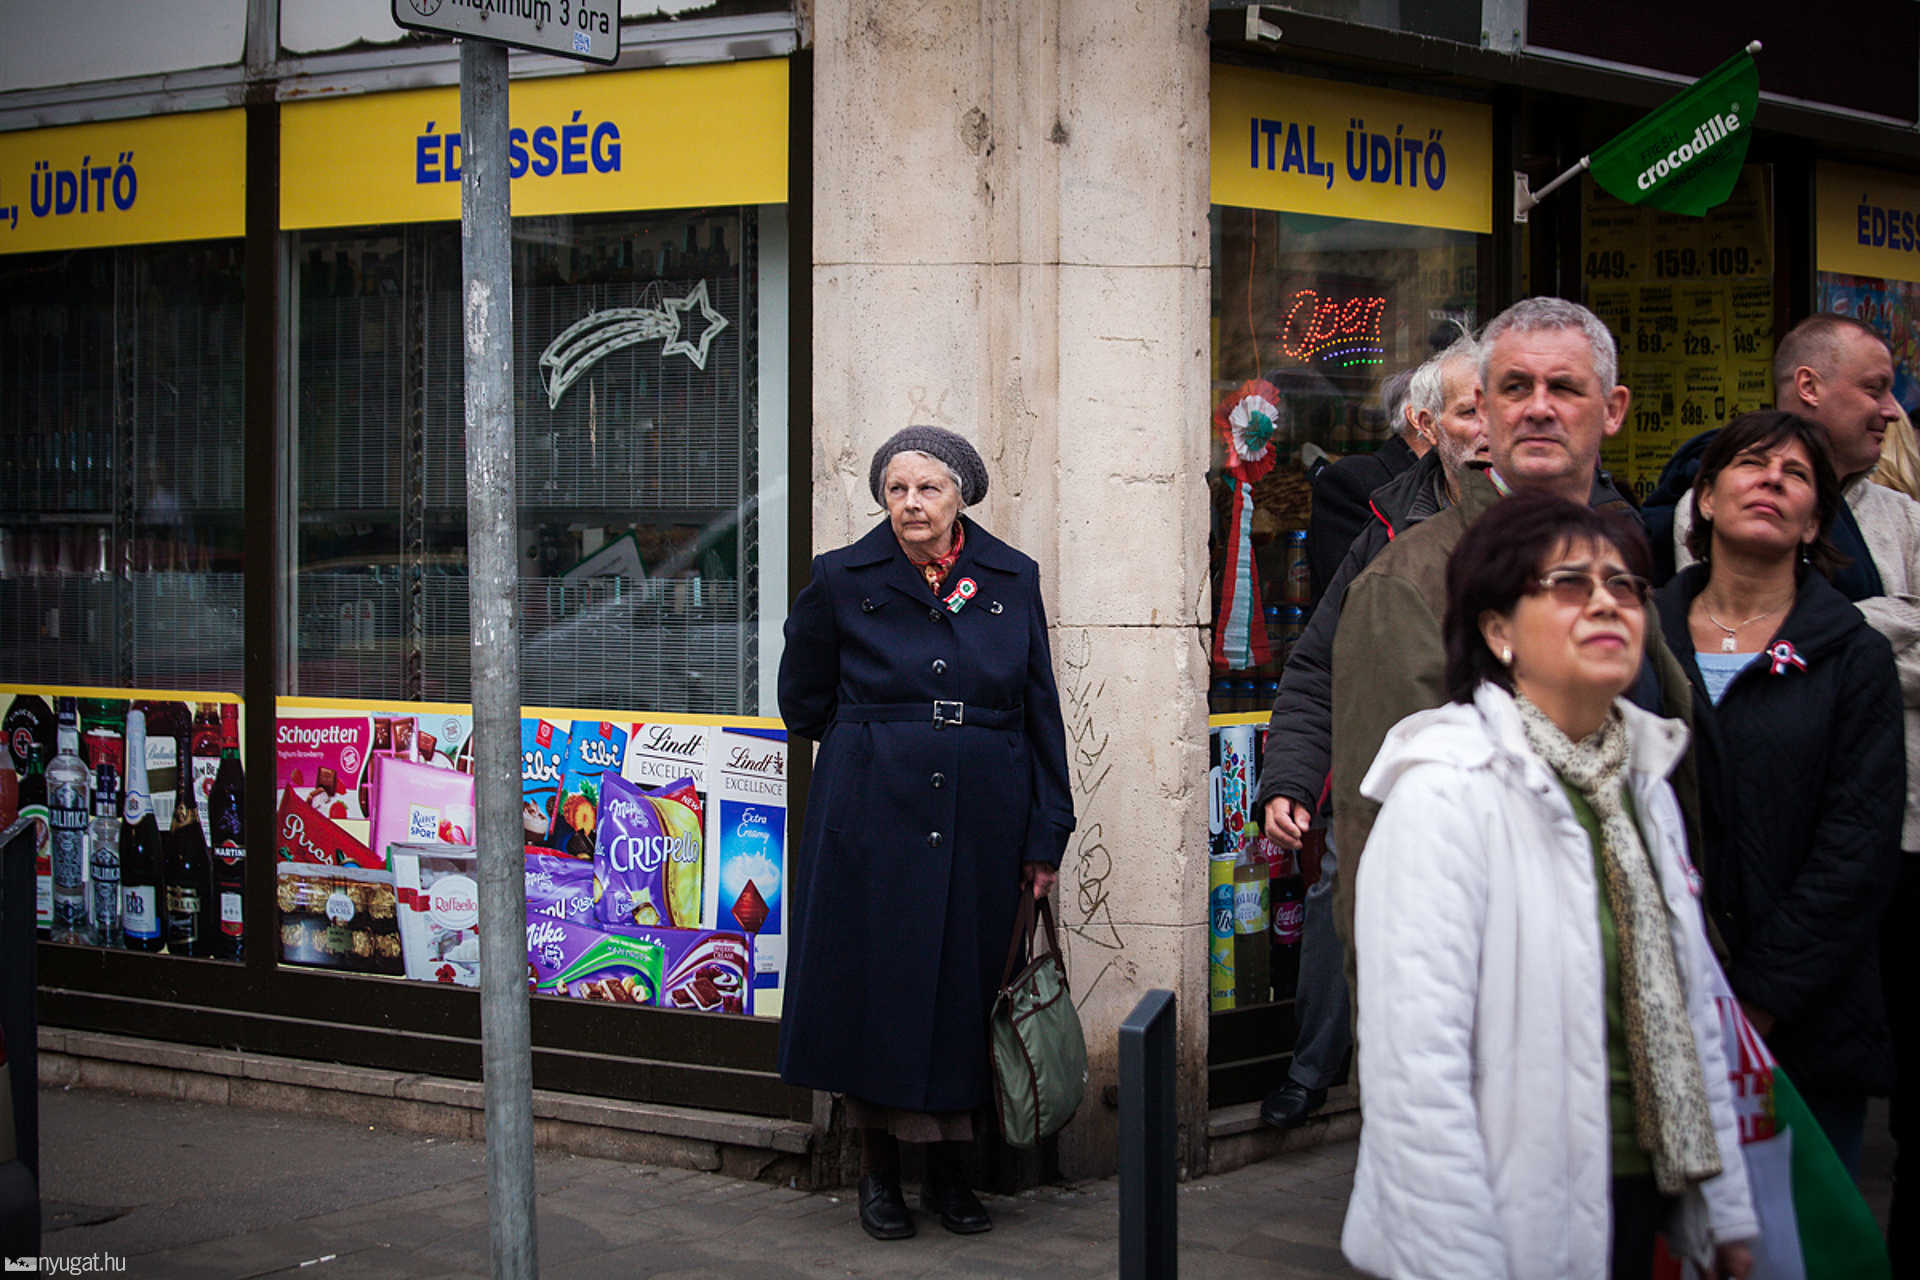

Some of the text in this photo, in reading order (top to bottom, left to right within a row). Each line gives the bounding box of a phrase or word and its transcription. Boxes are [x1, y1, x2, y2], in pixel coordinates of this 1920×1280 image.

[452, 0, 609, 35] ximum 3 óra
[416, 111, 621, 184] ÉDSSÉG
[1250, 117, 1447, 192] ITAL, ÜDÍTŐ
[1637, 112, 1741, 191] crocodille
[29, 151, 138, 219] ÜDÍTŐ
[1857, 192, 1920, 253] ÉDES
[1281, 288, 1387, 362] Open
[277, 725, 359, 748] Schogetten
[580, 739, 620, 766] tibi
[726, 747, 774, 772] Lindt
[724, 776, 783, 797] EXCELLENCE
[410, 826, 436, 840] SPORT
